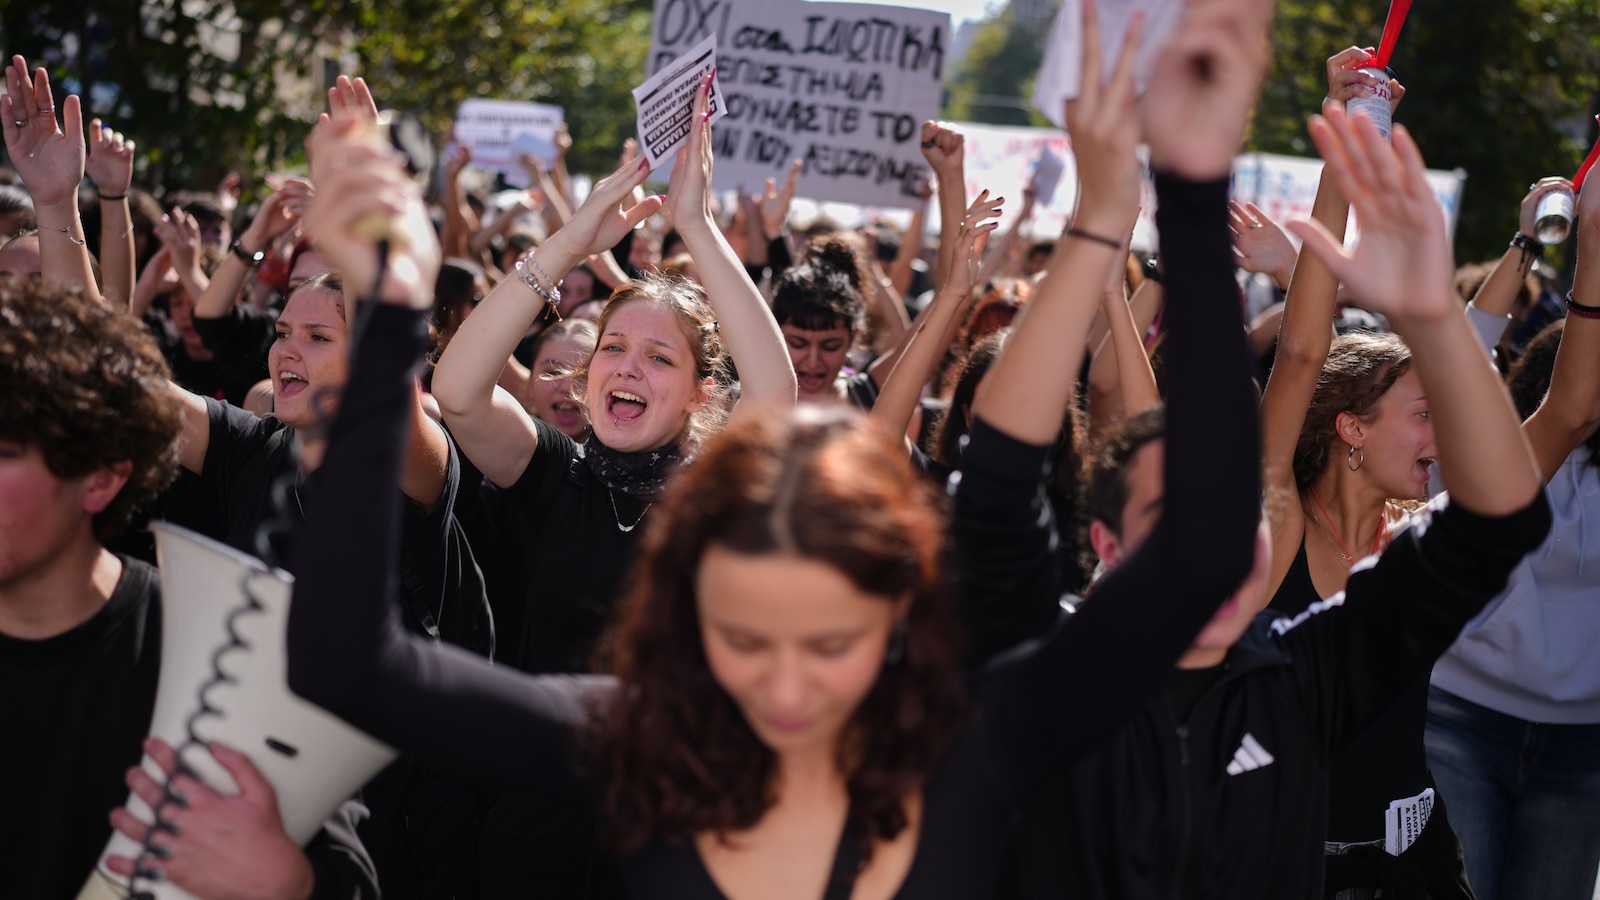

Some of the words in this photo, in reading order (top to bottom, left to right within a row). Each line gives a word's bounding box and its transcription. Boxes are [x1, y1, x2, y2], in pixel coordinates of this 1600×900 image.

[658, 0, 733, 46] ΟΧΙ
[678, 82, 701, 104] ΟΥΜΕ
[642, 101, 677, 129] ΔΗΜΟΣΙΑ
[870, 111, 916, 143] ΤΟ
[647, 119, 675, 143] ΓΑΛΛΙΑ
[653, 129, 684, 156] ΕΛΛΑΔΑ
